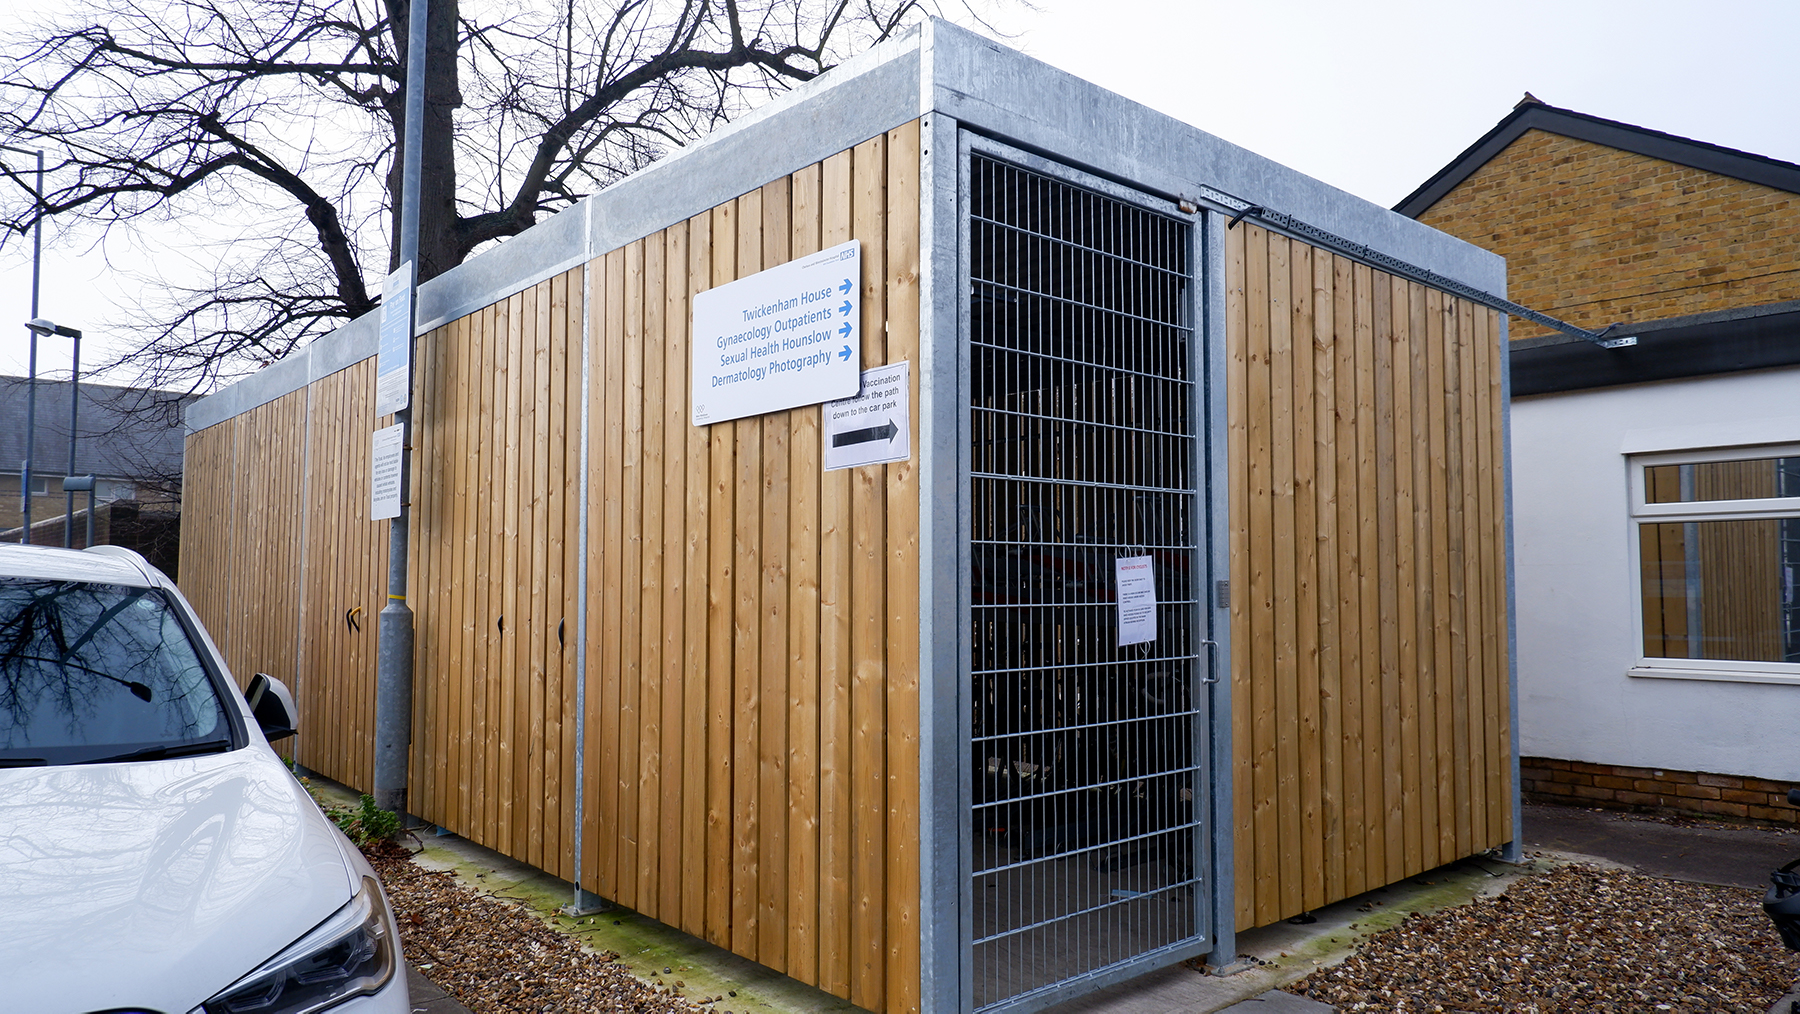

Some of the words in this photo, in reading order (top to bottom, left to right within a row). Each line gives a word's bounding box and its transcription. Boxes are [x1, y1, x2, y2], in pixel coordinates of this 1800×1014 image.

[840, 248, 855, 261] NHS
[743, 297, 798, 322] Twickenham
[801, 287, 832, 306] House
[717, 324, 772, 350] Gynaecology
[775, 307, 832, 335] Outpatients
[720, 348, 748, 367] Sexual
[751, 340, 780, 360] Health
[783, 329, 832, 351] Hounslow
[712, 366, 767, 388] Dermatology
[769, 349, 832, 375] Photography
[862, 374, 901, 388] Vaccination
[871, 390, 883, 399] the
[884, 387, 899, 398] path
[832, 411, 850, 420] down
[858, 405, 868, 415] the
[869, 403, 881, 412] car
[882, 401, 897, 412] park
